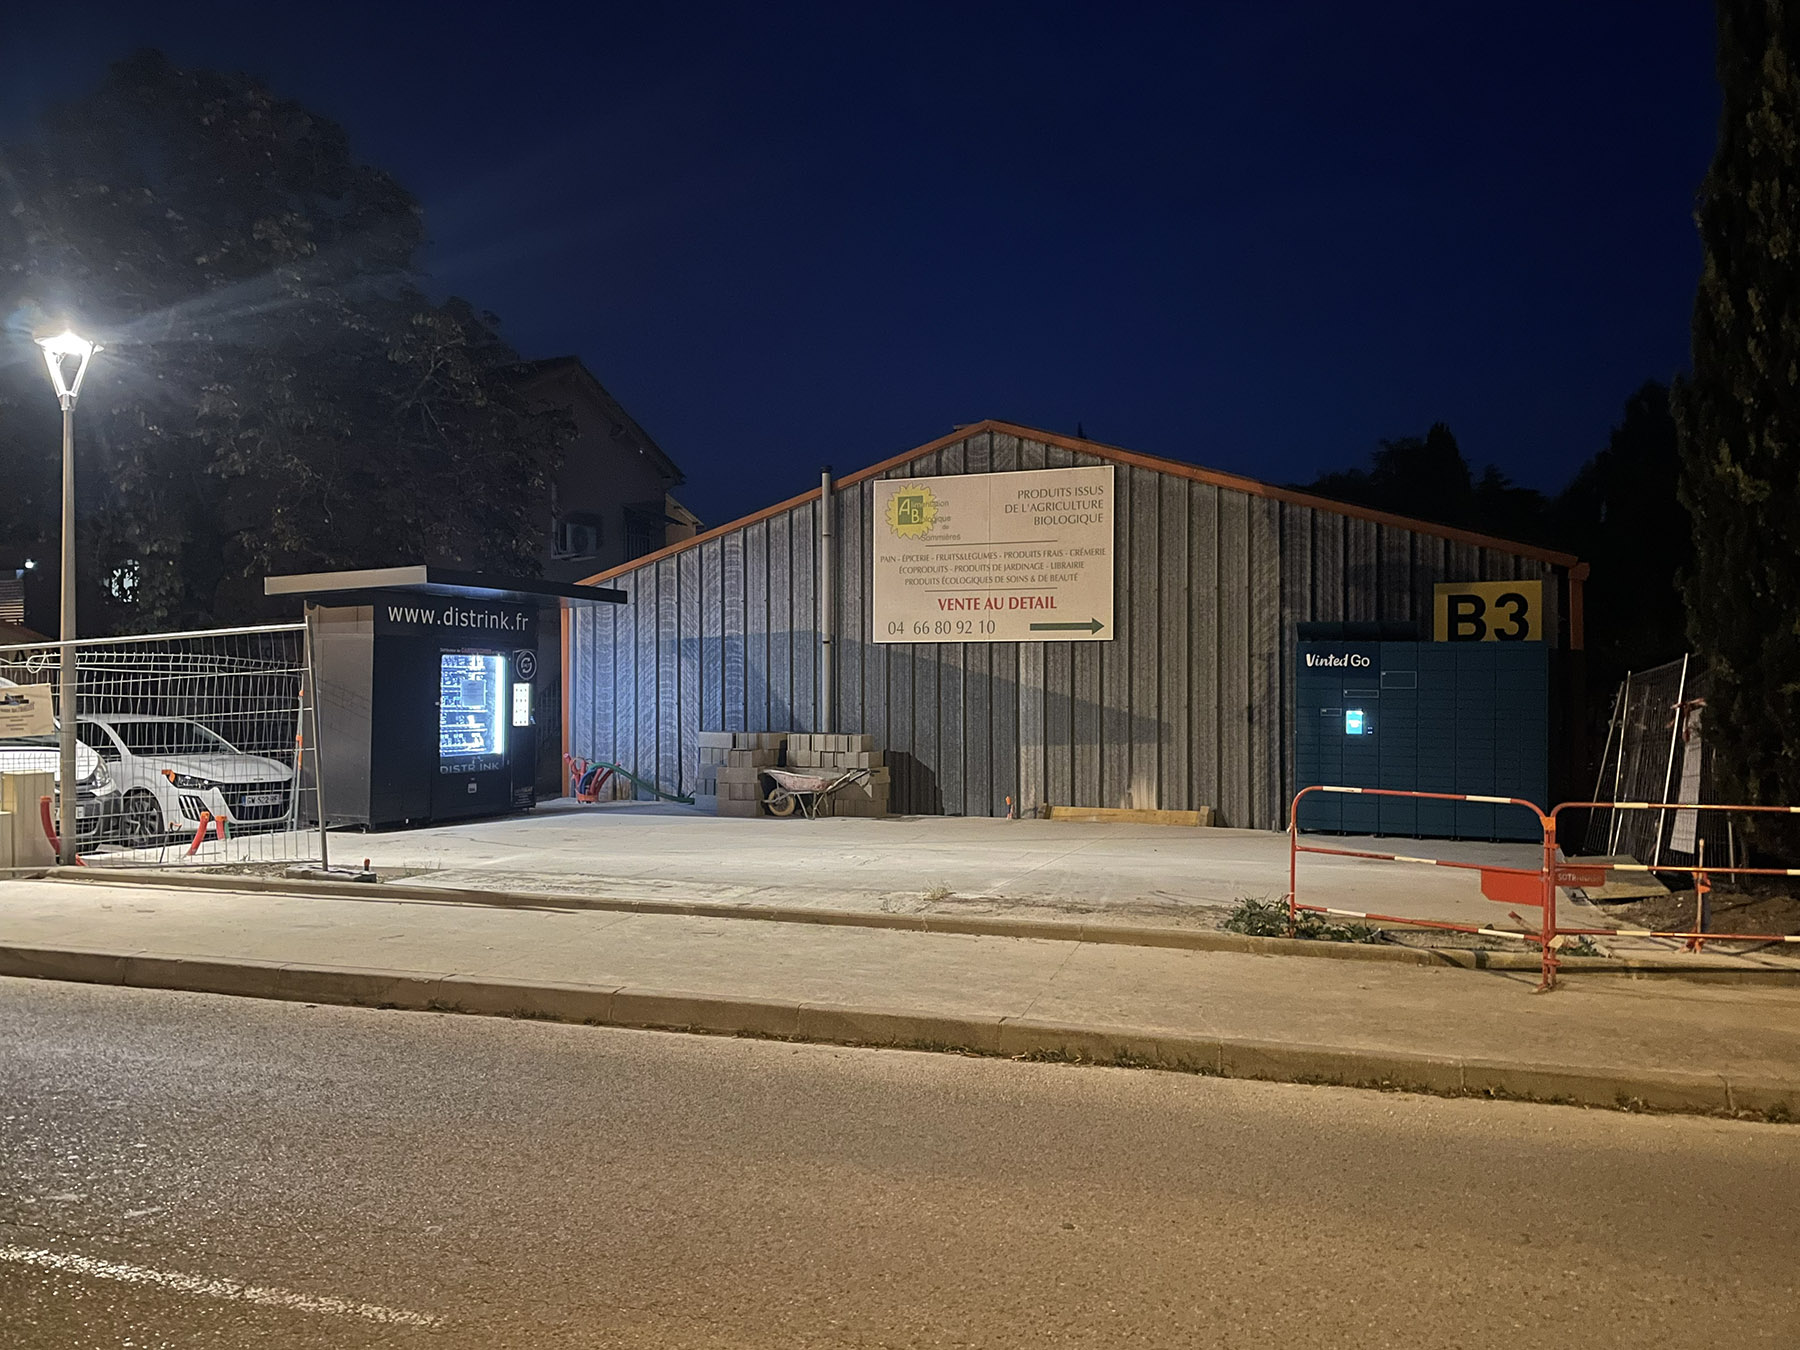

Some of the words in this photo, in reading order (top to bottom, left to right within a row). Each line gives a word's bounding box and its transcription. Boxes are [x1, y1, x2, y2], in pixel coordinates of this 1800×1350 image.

[1017, 487, 1072, 500] PRODUITS
[1075, 485, 1104, 497] ISSUS
[1004, 503, 1019, 514] DE
[1021, 499, 1104, 513] L'AGRICULTURE
[1033, 513, 1104, 526] BIOLOGIQUE
[880, 555, 897, 563] PAIN
[1003, 550, 1041, 559] PRODUITS
[1042, 549, 1064, 558] FRAIS
[954, 563, 991, 573] PRODUITS
[992, 563, 1002, 572] DE
[1003, 562, 1044, 573] JARDINAGE
[1050, 561, 1085, 570] LIBRAIRIE
[904, 577, 940, 586] PRODUITS
[994, 575, 1004, 584] DE
[1006, 575, 1029, 584] SOINS
[1030, 575, 1036, 583] &
[1038, 574, 1047, 583] DE
[938, 598, 981, 611] VENTE
[984, 597, 1005, 610] AU
[1008, 596, 1058, 610] DETAIL
[388, 606, 528, 631] www.distrink.fr
[1447, 593, 1529, 642] B3
[888, 621, 905, 635] 04
[913, 621, 930, 634] 66
[934, 620, 951, 634] 80
[956, 620, 973, 634] 92
[979, 620, 996, 633] 10
[1306, 653, 1349, 667] Vinted
[1350, 654, 1371, 667] Go
